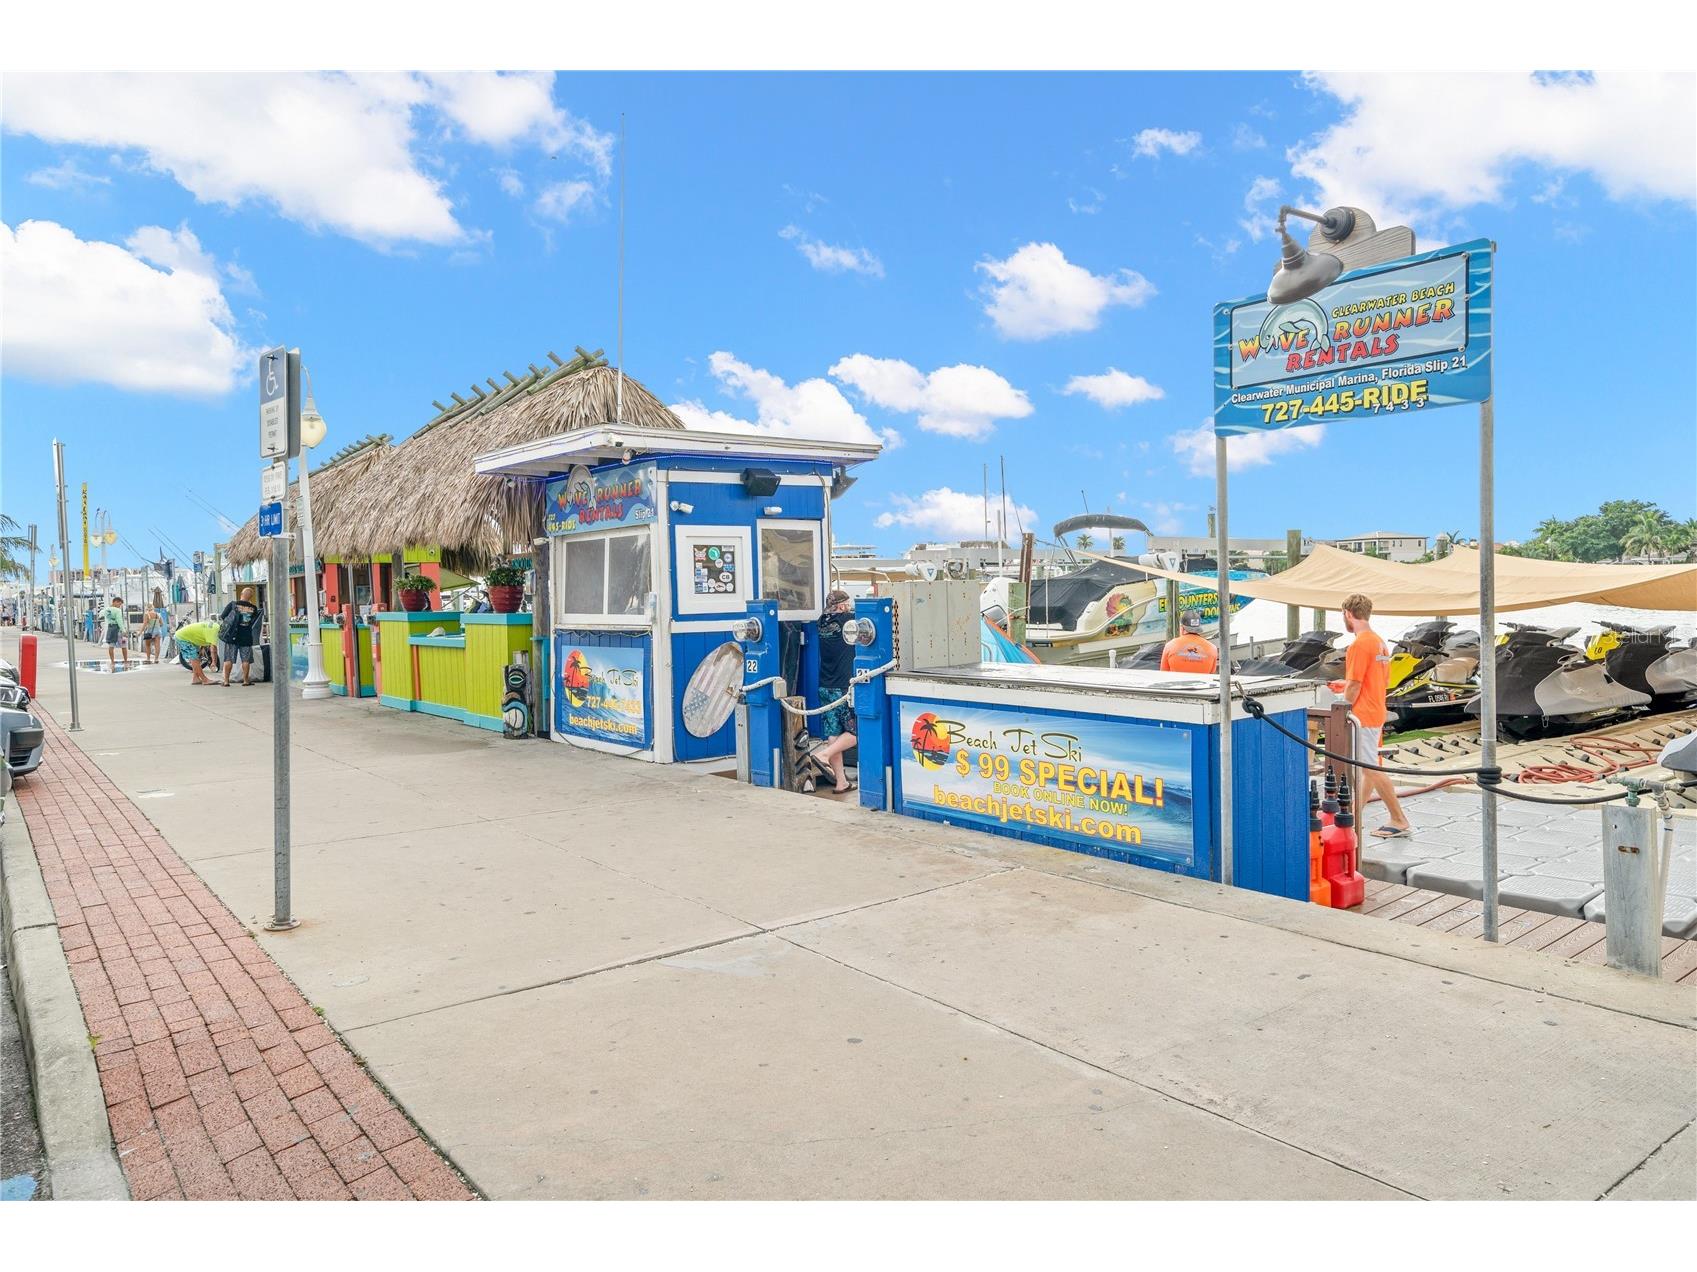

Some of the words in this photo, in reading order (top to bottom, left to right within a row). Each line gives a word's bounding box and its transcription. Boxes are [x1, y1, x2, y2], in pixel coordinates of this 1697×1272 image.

[1332, 292, 1407, 318] CLEARWATER
[1411, 282, 1455, 301] BEACH
[1238, 328, 1310, 362] WVE
[1333, 298, 1455, 342] RUNNER
[1286, 334, 1400, 372] RENTALS
[1231, 387, 1285, 404] Clearwater
[1286, 379, 1335, 395] Municipal
[1338, 373, 1379, 388] Marina,
[1382, 364, 1422, 380] Florida
[1425, 360, 1448, 374] Slip
[1452, 355, 1467, 368] 21
[1261, 380, 1429, 425] 727-445-RIDE
[557, 490, 588, 509] WVE
[596, 478, 642, 502] RUNNER
[578, 503, 624, 525] RENTALS
[634, 508, 646, 520] Slip
[1159, 592, 1218, 613] EOUNTERS
[607, 669, 621, 685] Jet
[622, 670, 639, 687] Ski
[747, 661, 757, 673] 22
[569, 713, 637, 735] beachjetski.com
[935, 720, 998, 750] Beach
[1003, 728, 1037, 756] Jet
[1041, 732, 1082, 763] Ski
[978, 752, 1010, 781] 99
[1019, 758, 1164, 808] SPECIAL!
[933, 784, 1142, 845] beachjetski.com
[993, 781, 1029, 799] BOOK
[1033, 787, 1085, 808] ONLINE
[1089, 798, 1128, 816] NOW!
